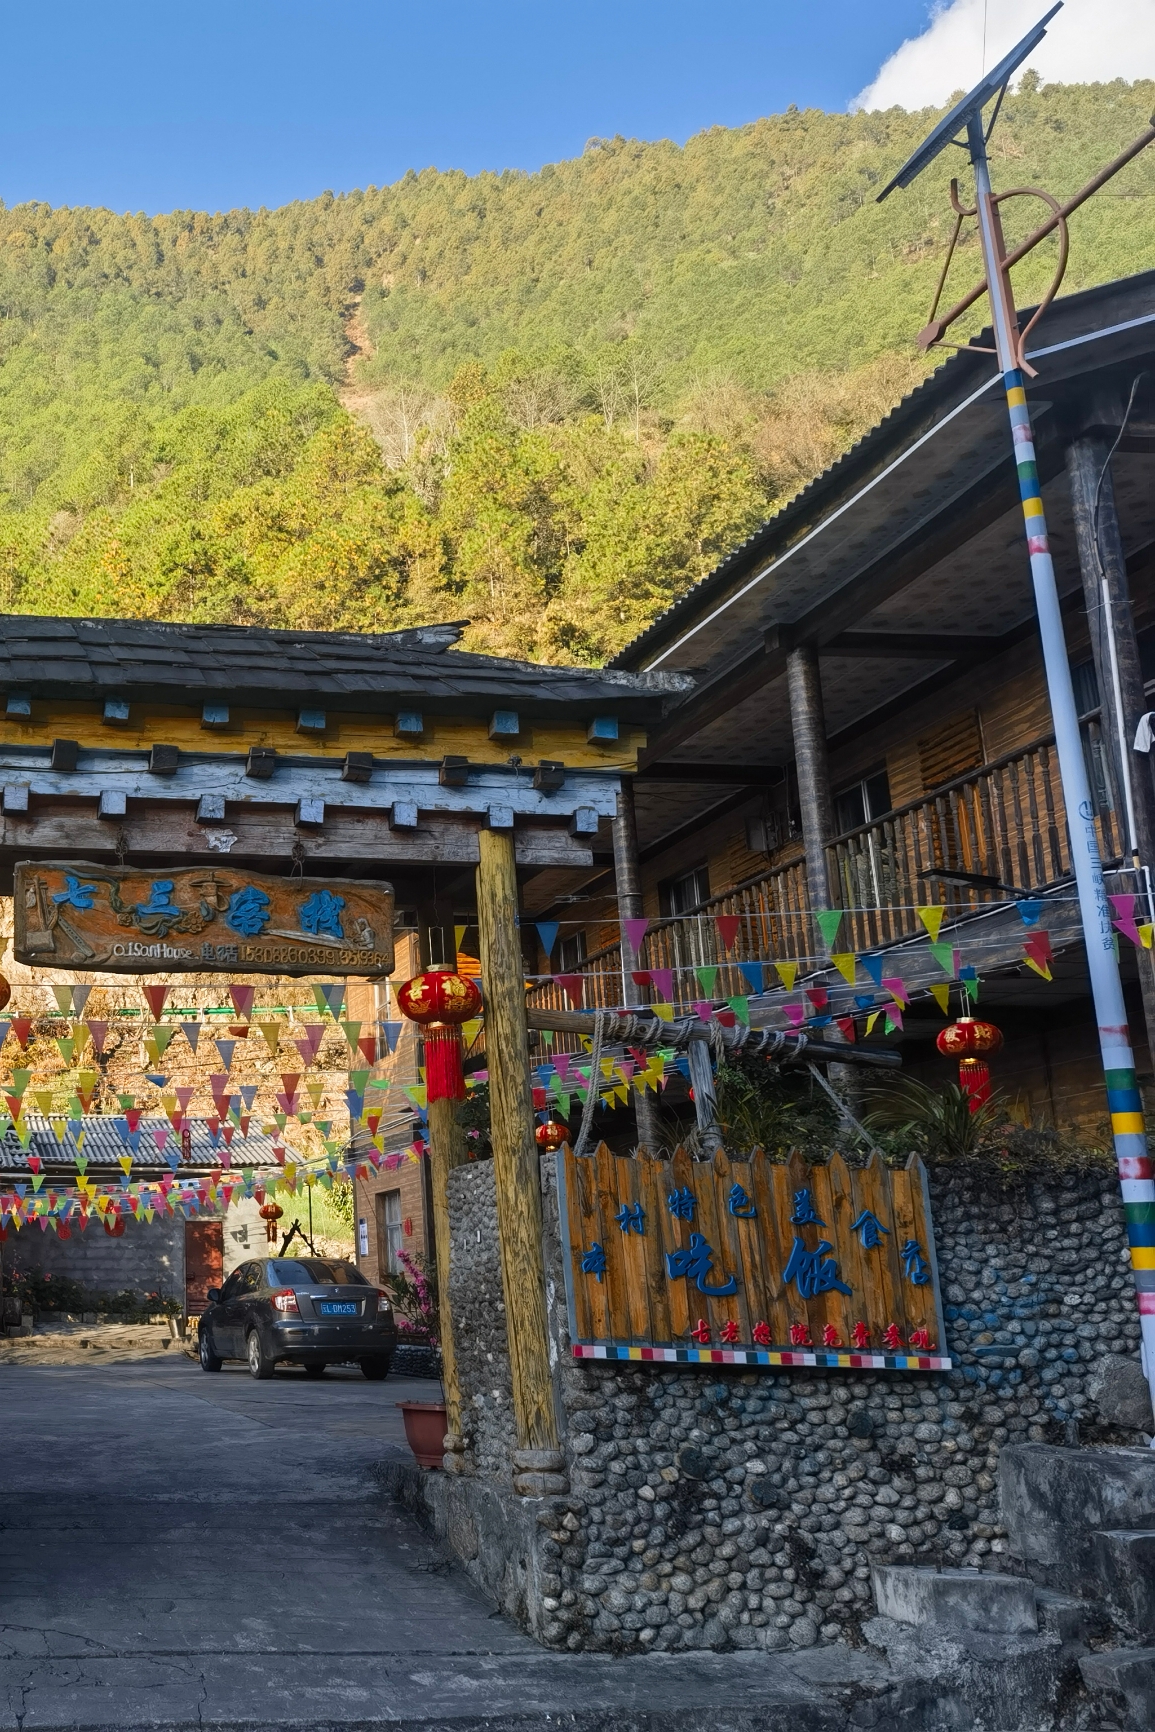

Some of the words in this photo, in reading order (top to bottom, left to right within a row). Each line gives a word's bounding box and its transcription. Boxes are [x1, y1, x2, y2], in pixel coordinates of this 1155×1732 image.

[1085, 823, 1116, 951] 中国三峡精准扶贫
[580, 1183, 930, 1285] 本村特色美食店
[664, 1233, 853, 1299] 吃饭
